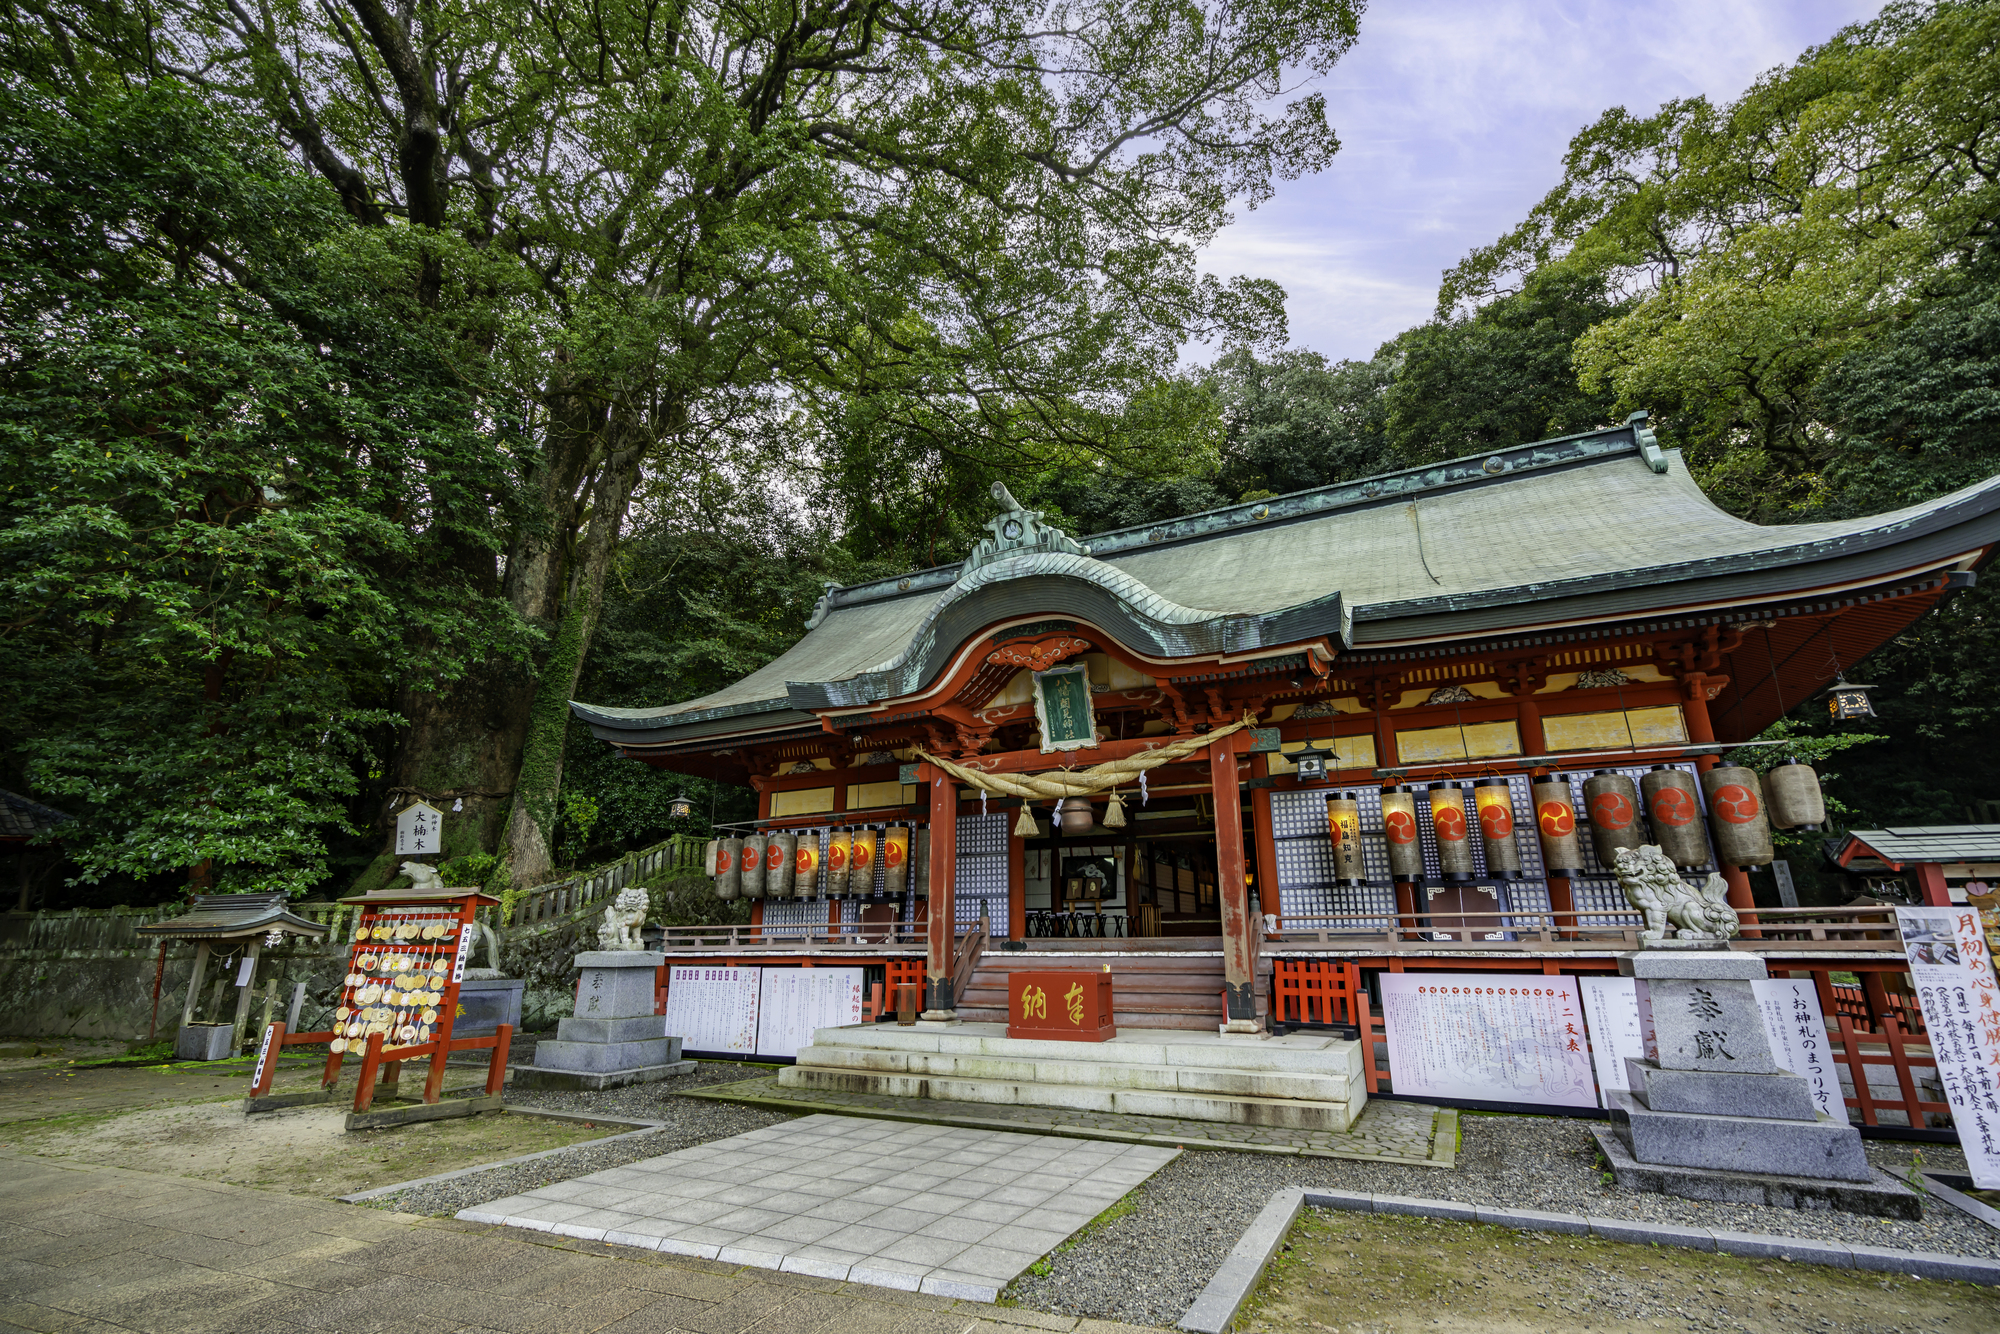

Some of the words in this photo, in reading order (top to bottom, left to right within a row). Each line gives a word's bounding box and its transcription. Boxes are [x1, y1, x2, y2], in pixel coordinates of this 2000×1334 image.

[413, 811, 427, 851] 大楠木
[1558, 990, 1580, 1052] 十二支表
